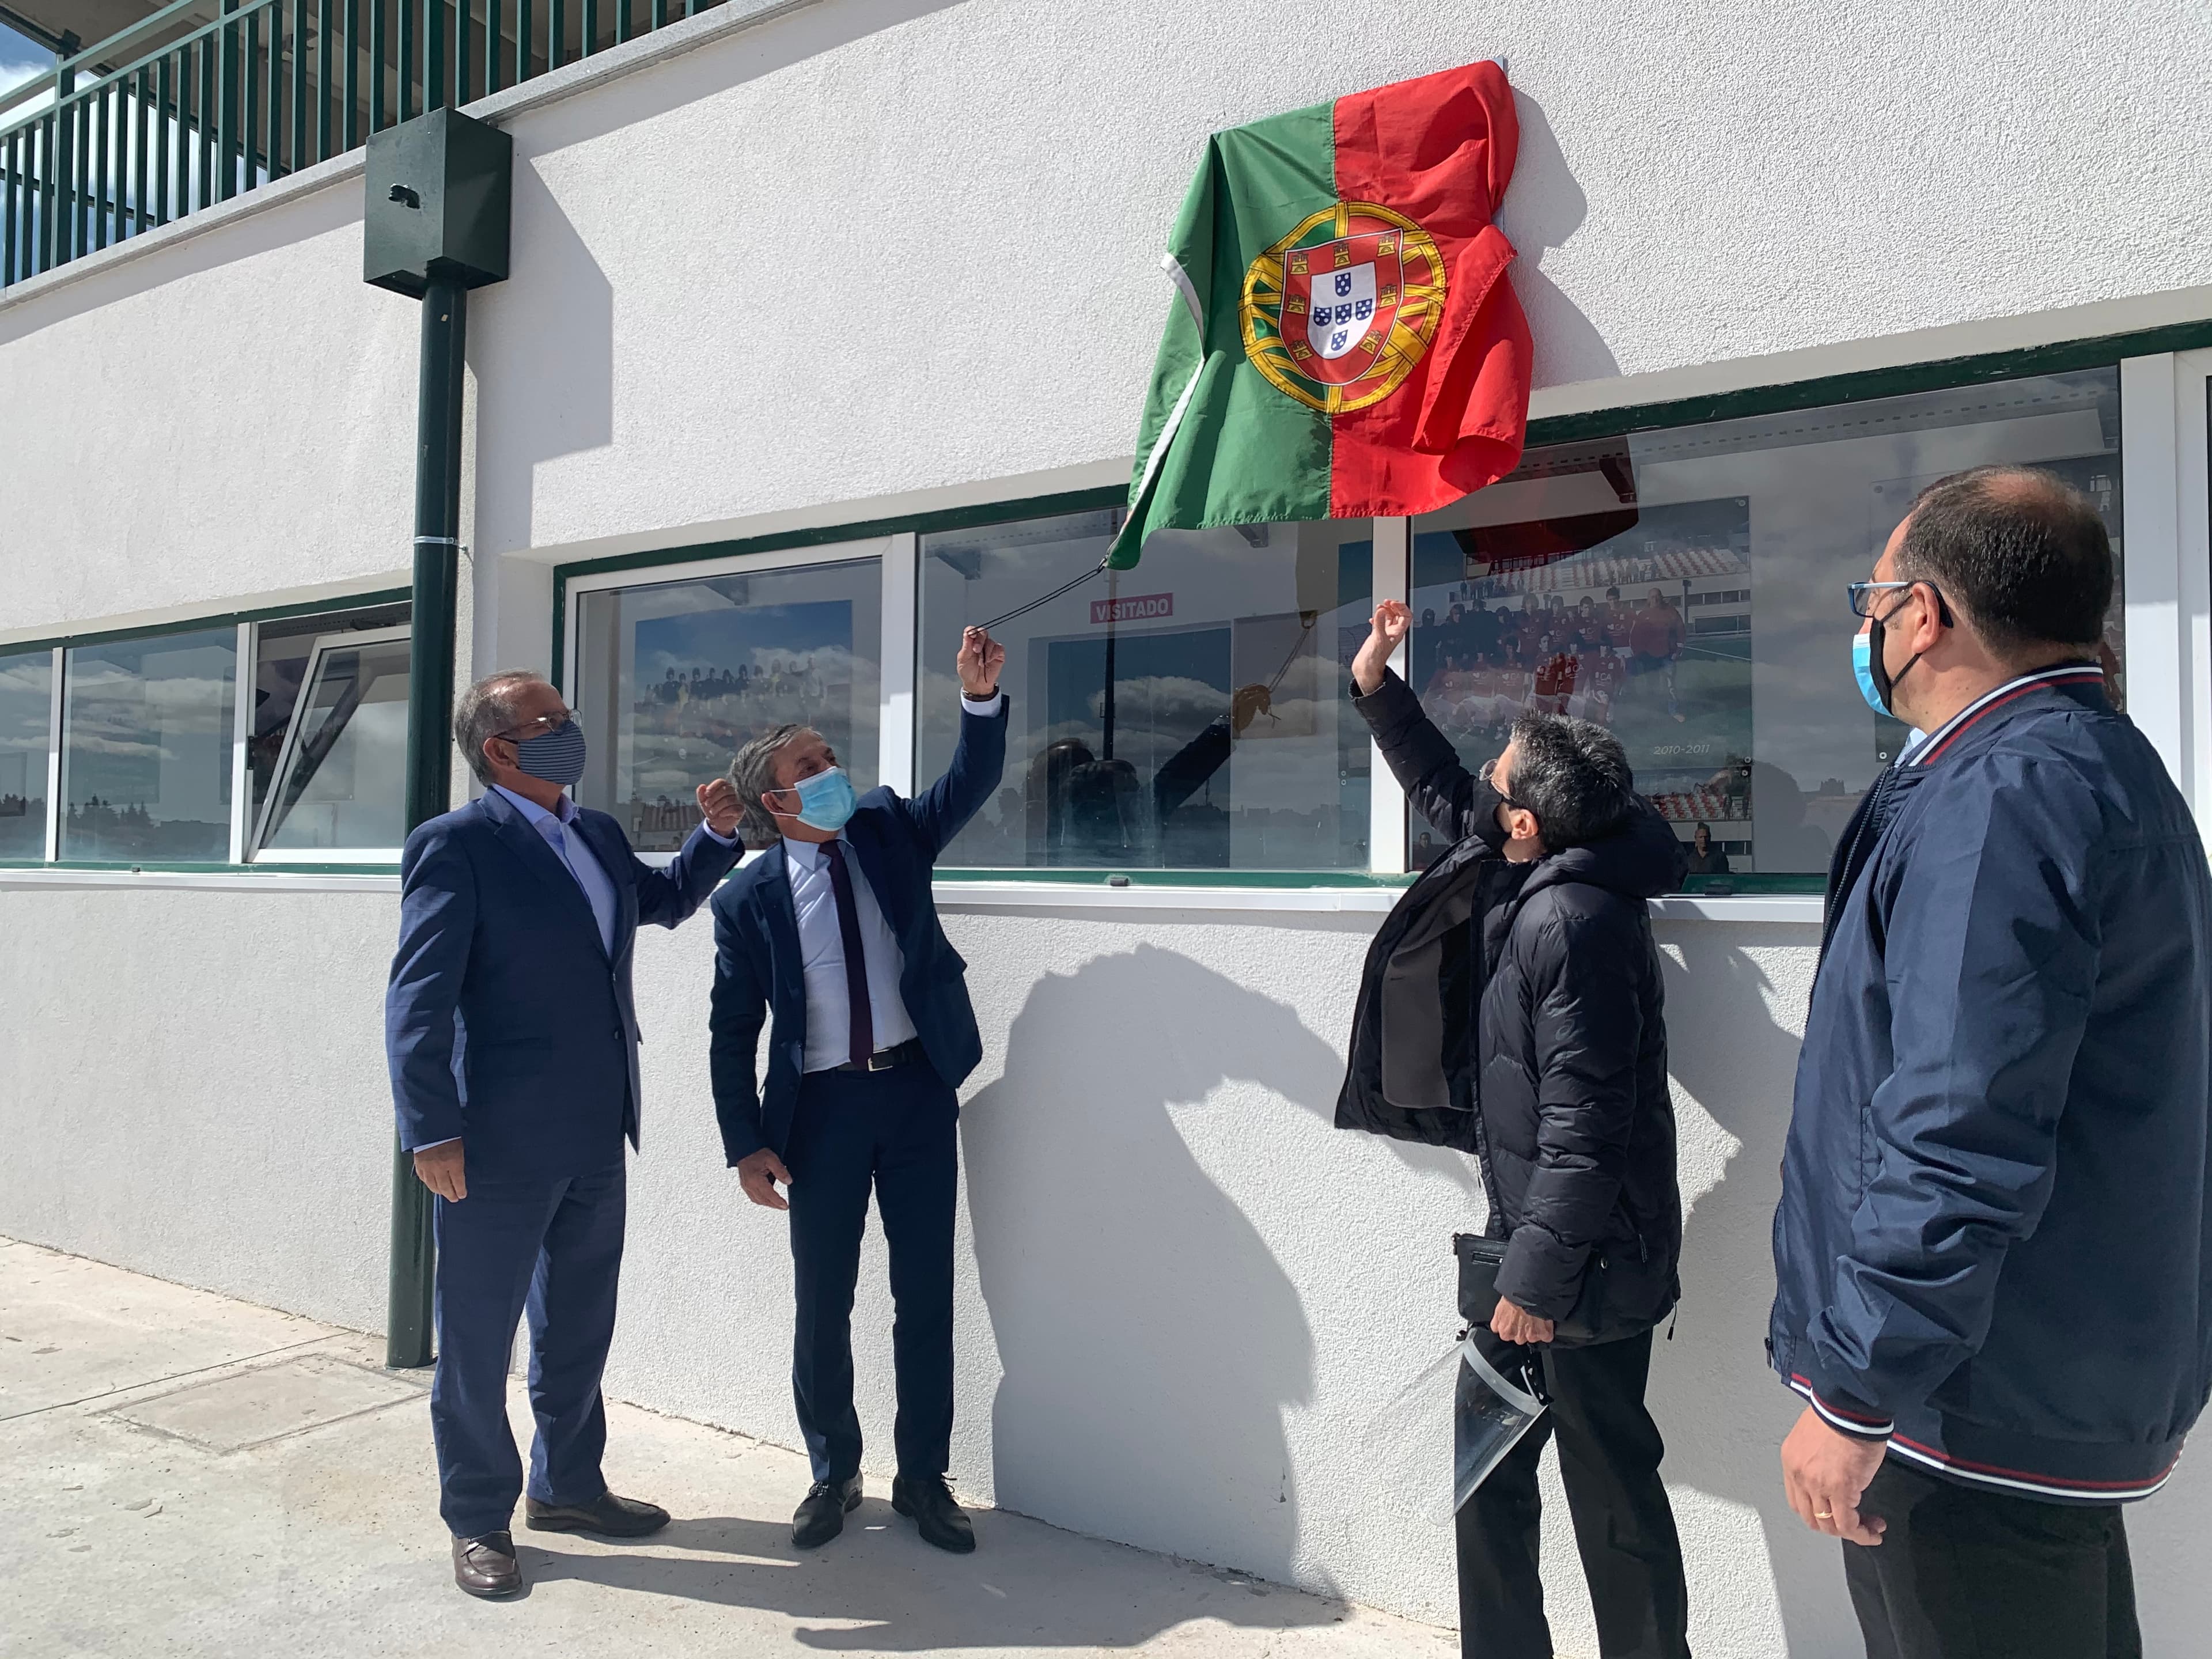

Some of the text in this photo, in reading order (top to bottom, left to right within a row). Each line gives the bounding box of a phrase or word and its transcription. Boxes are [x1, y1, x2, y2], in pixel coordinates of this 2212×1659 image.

[1096, 598, 1169, 621] VISITADO
[1600, 672, 1612, 680] CA
[1653, 744, 1710, 755] 2010-2011
